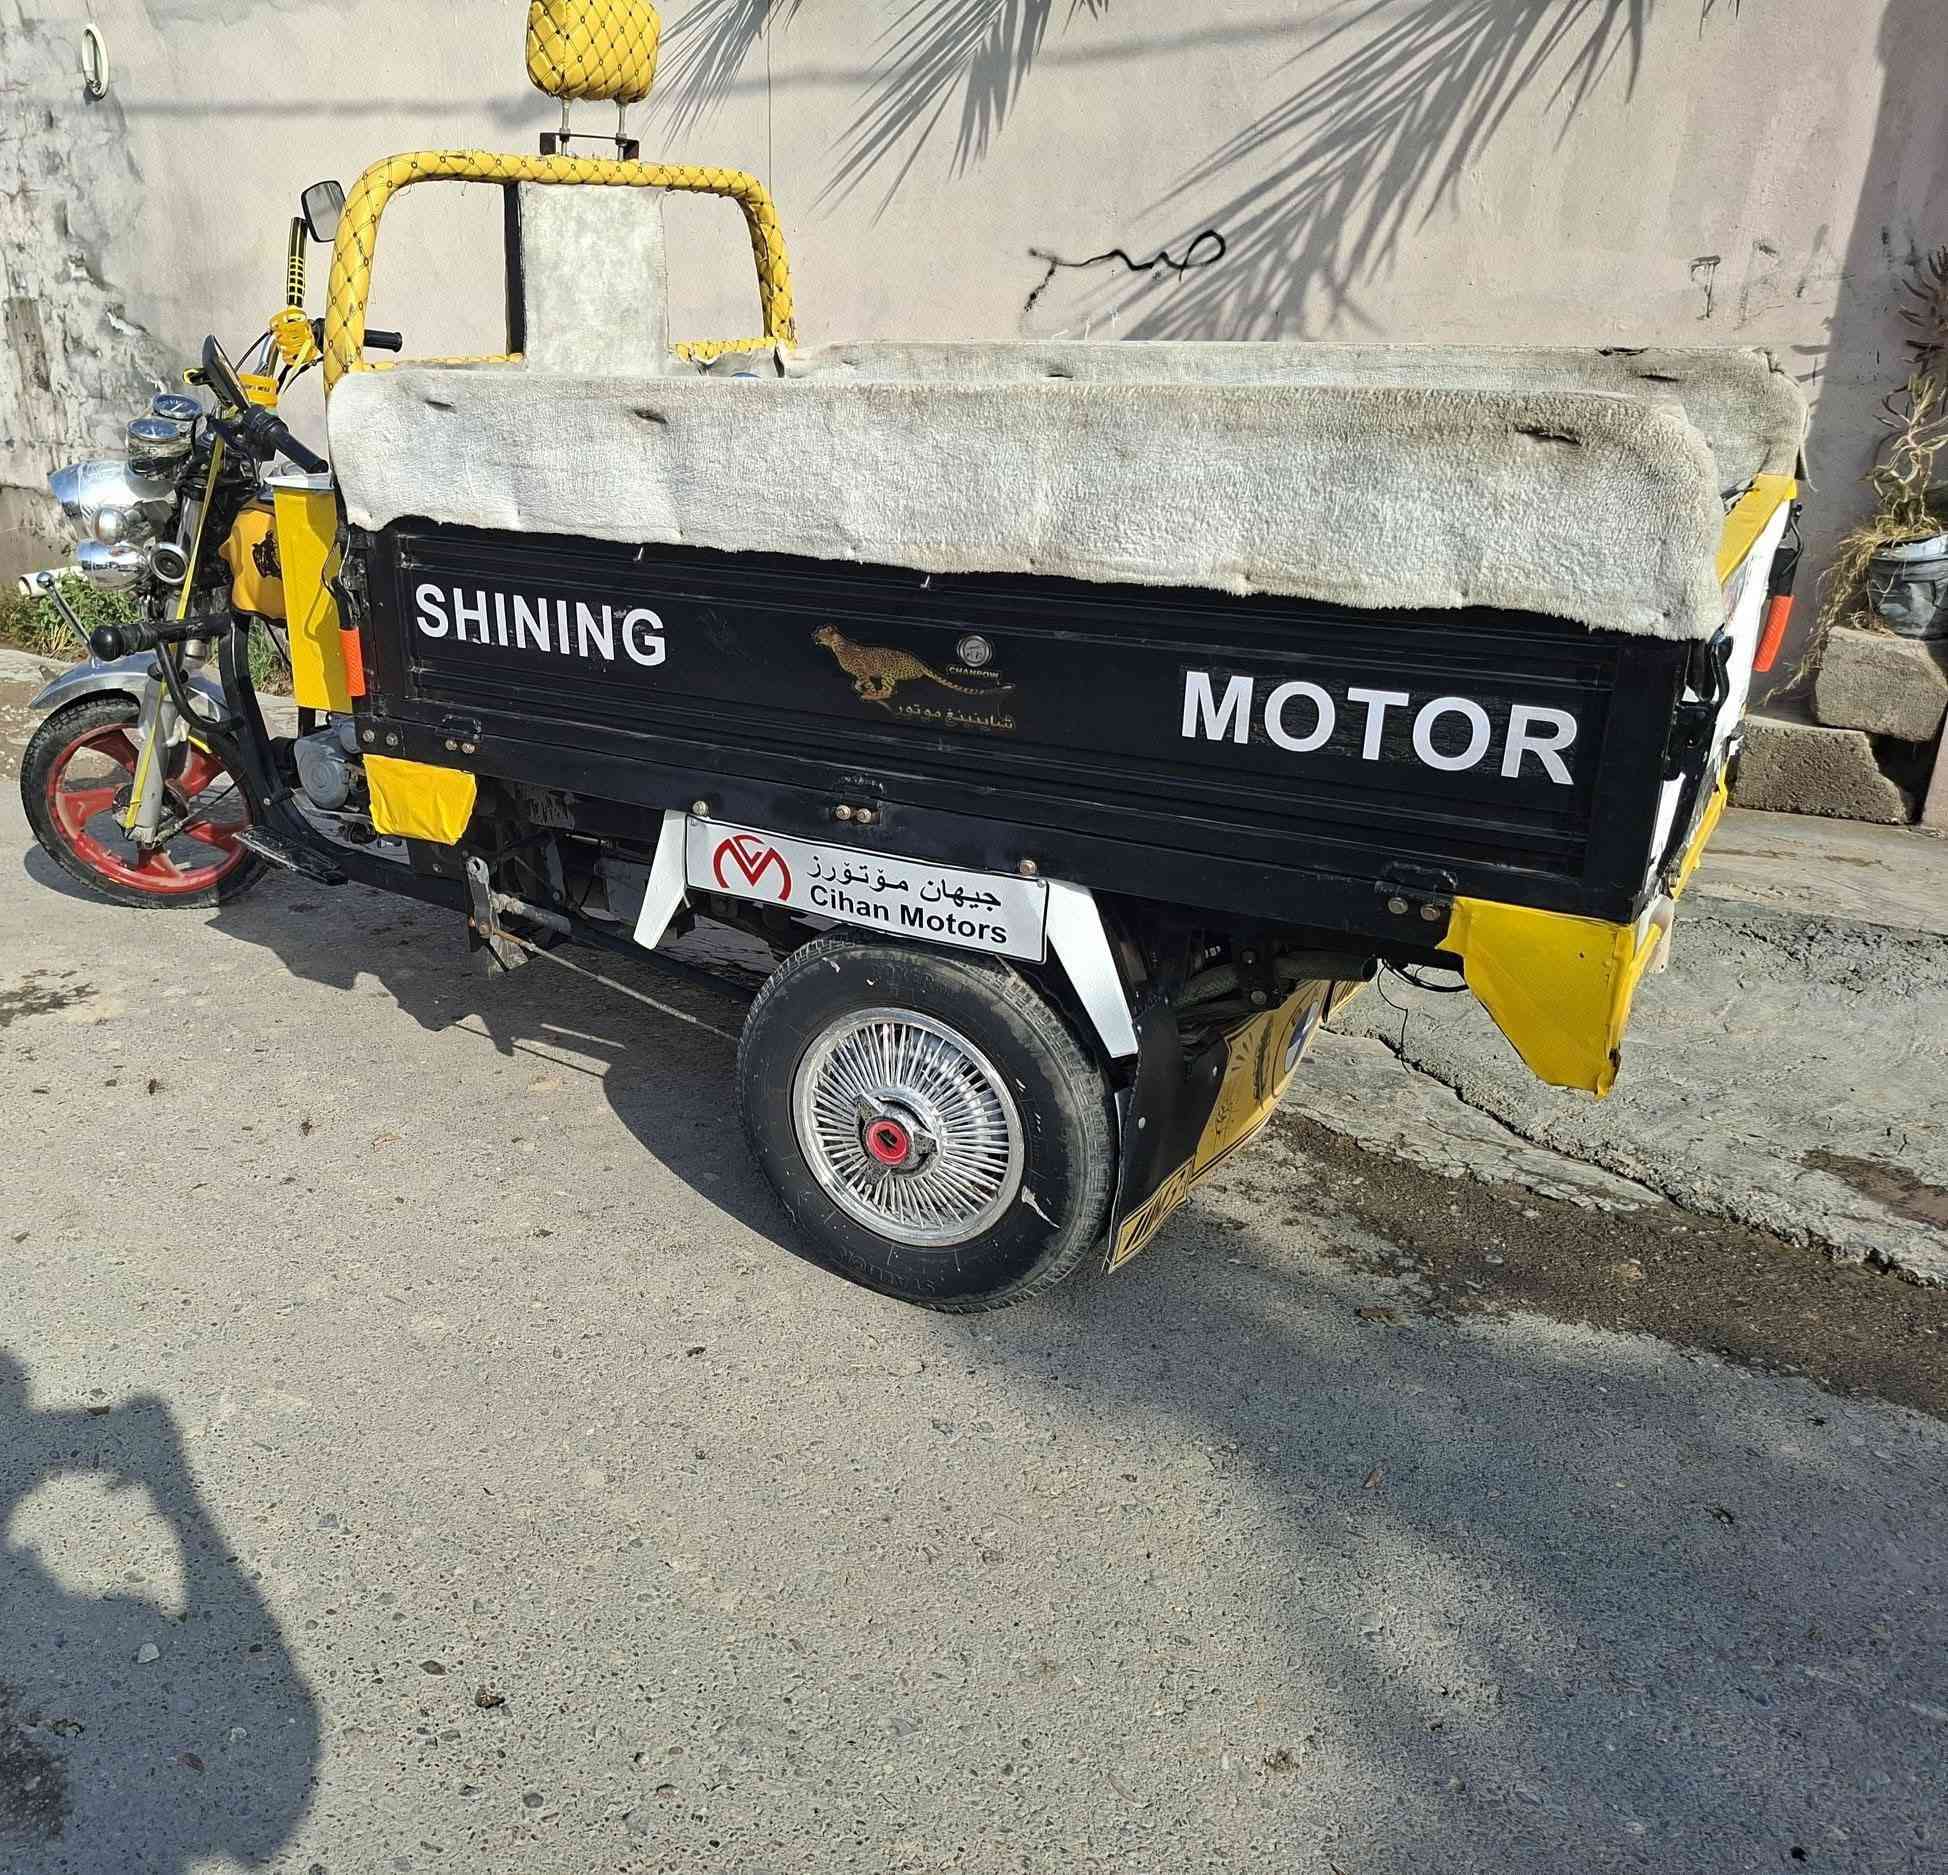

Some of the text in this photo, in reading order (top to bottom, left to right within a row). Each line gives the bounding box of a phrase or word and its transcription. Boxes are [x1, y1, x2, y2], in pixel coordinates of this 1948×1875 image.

[415, 583, 666, 666] SHINING
[1181, 671, 1578, 786] MOTOR
[810, 884, 1008, 944] Cihan Motors
